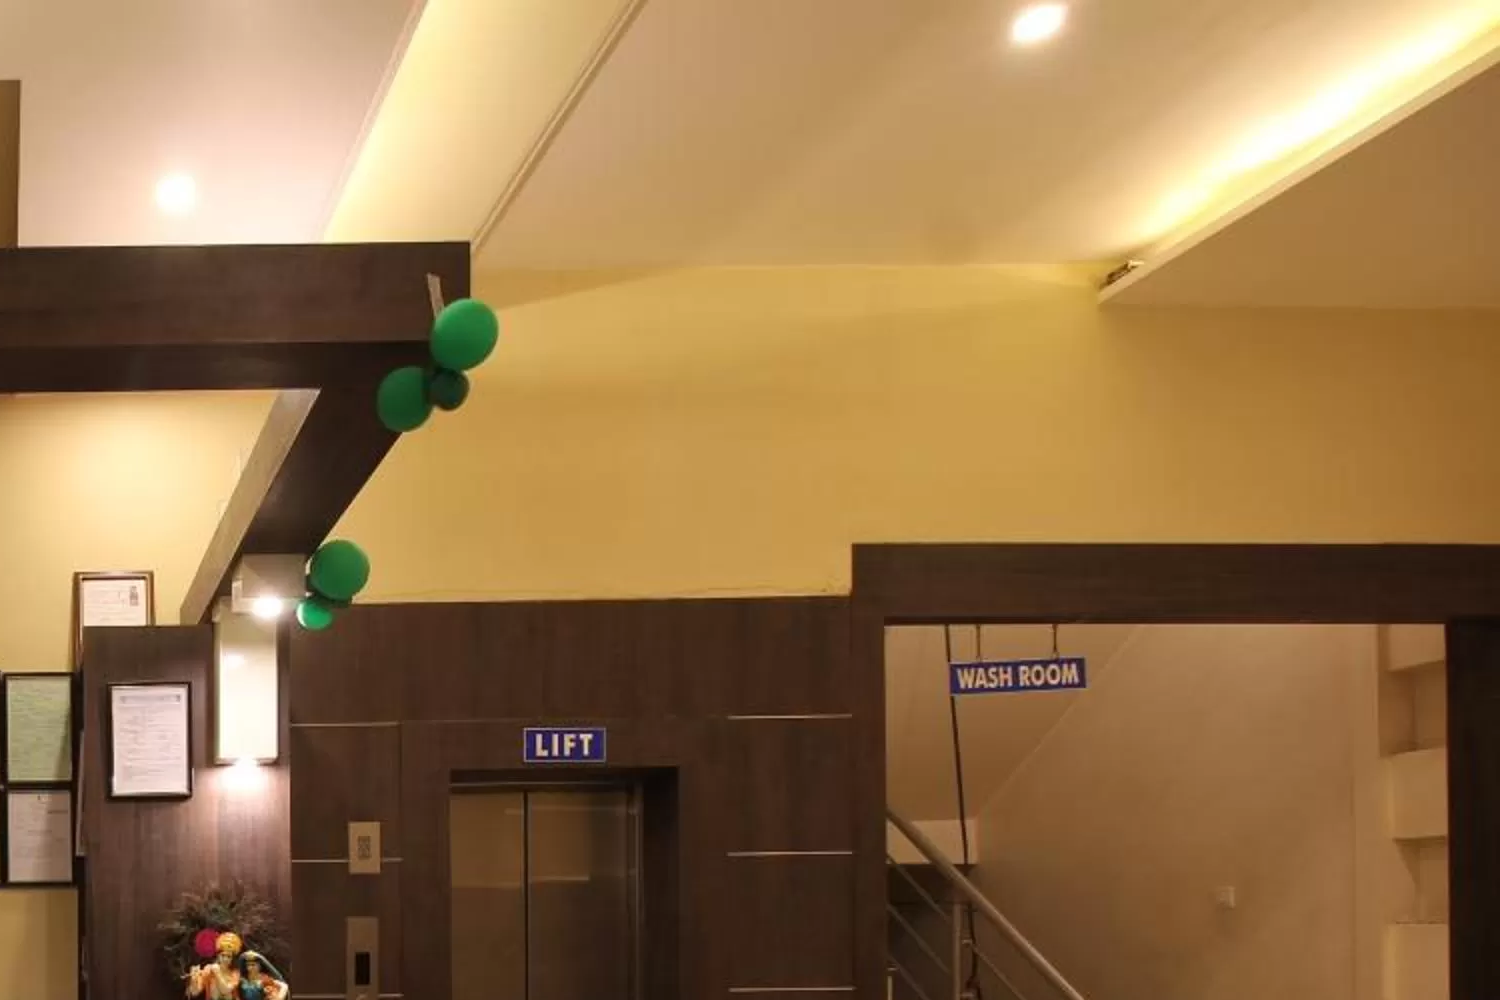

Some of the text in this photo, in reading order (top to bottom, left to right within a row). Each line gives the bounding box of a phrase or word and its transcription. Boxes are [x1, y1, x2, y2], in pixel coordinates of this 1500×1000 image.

[956, 662, 1080, 689] WASH ROOM
[535, 733, 594, 757] LIFT
